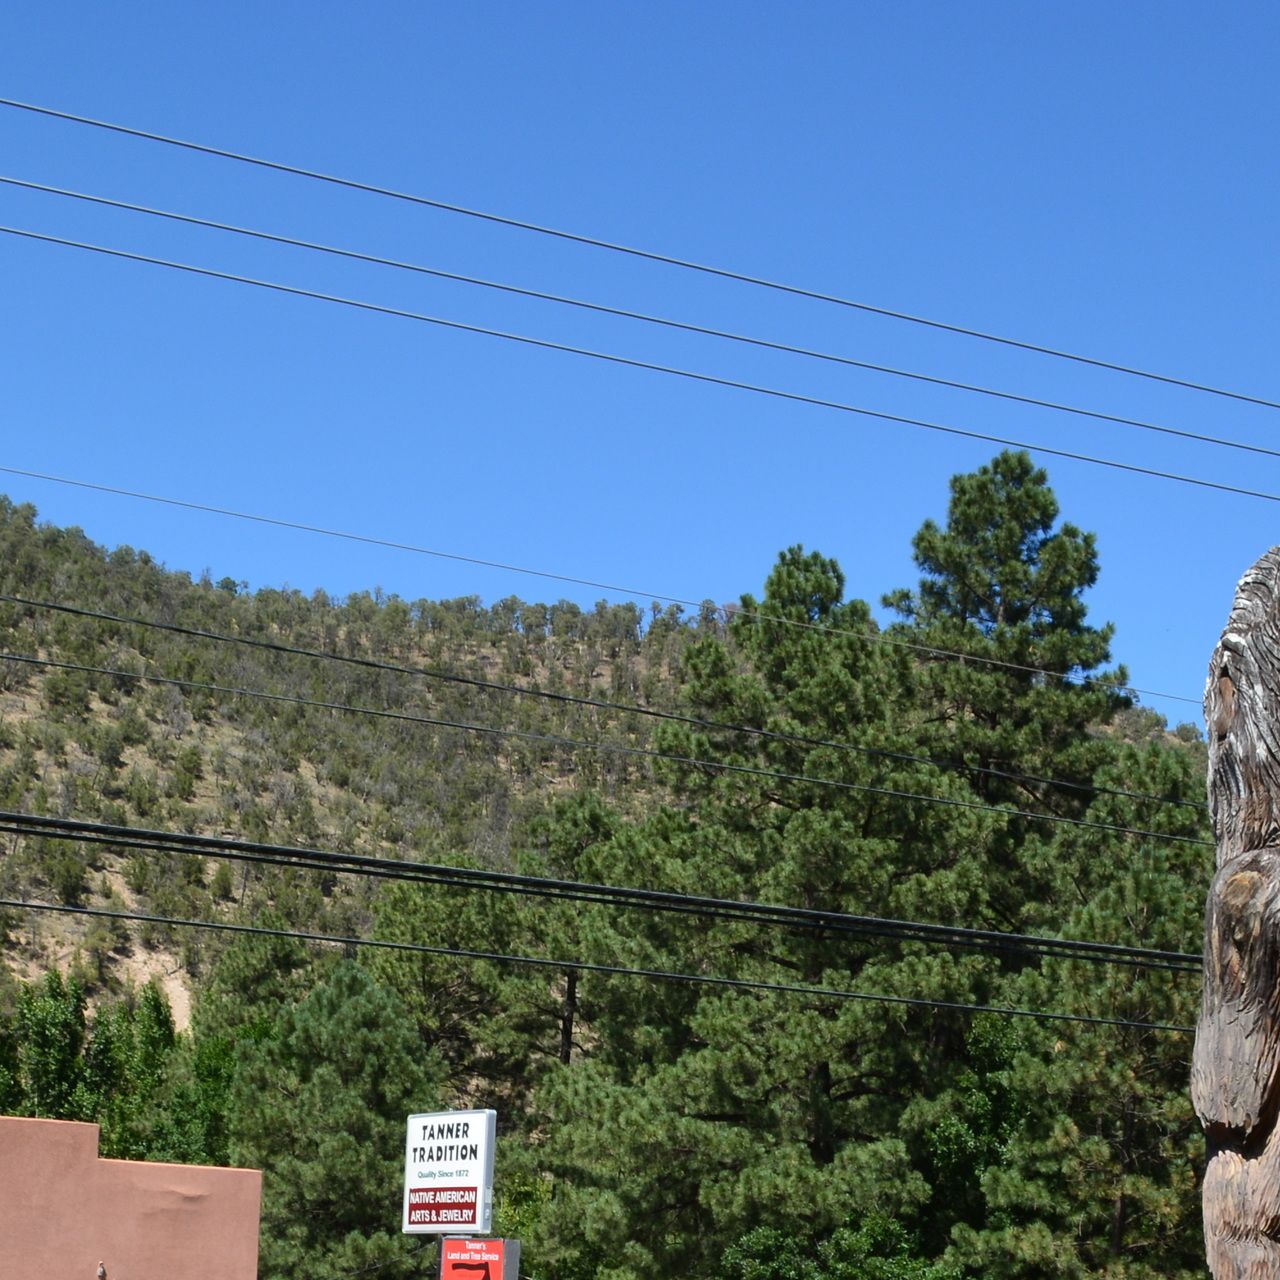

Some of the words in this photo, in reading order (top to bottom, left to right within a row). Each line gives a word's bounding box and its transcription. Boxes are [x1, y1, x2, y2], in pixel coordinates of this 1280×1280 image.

[423, 1122, 469, 1140] TANNER
[412, 1144, 478, 1163] TRADITION
[417, 1170, 436, 1180] Quality
[437, 1170, 454, 1178] Since
[455, 1169, 469, 1177] 1872
[410, 1191, 434, 1204] NATIVE
[435, 1190, 476, 1203] AMERICAN
[411, 1210, 429, 1222] ARTS
[431, 1210, 437, 1222] &
[438, 1209, 473, 1222] JEWELRY
[447, 1252, 460, 1260] Land
[470, 1252, 480, 1260] Tree
[481, 1252, 499, 1261] Service
